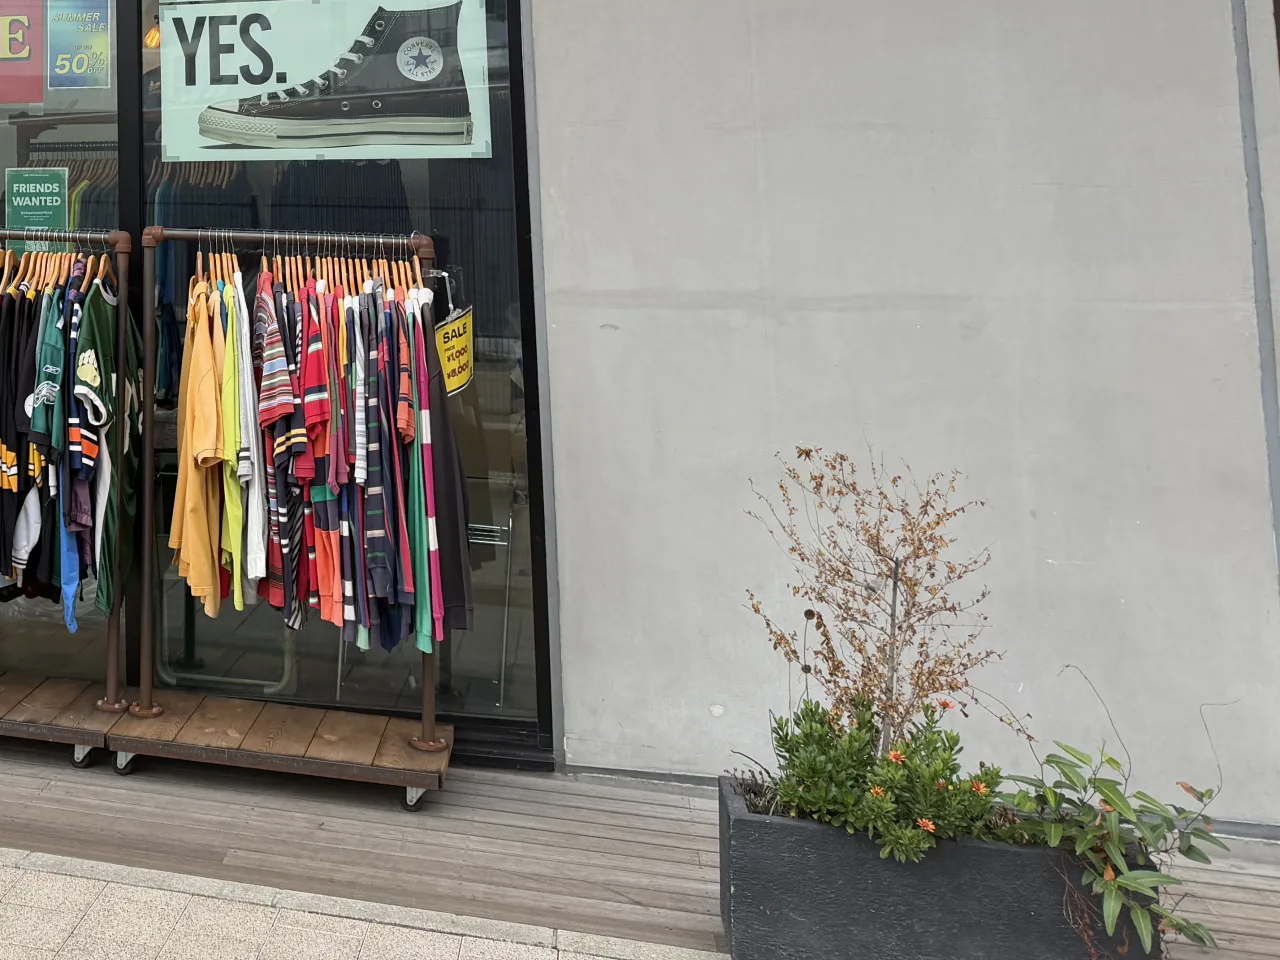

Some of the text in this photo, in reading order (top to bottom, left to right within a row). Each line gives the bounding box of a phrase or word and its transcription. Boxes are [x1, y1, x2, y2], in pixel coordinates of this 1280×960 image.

[52, 13, 100, 23] SUMMER
[77, 23, 106, 32] SALE
[172, 13, 287, 86] YES.
[13, 183, 59, 193] FRIENDS
[12, 196, 61, 206] WANTED
[443, 322, 467, 344] SALE
